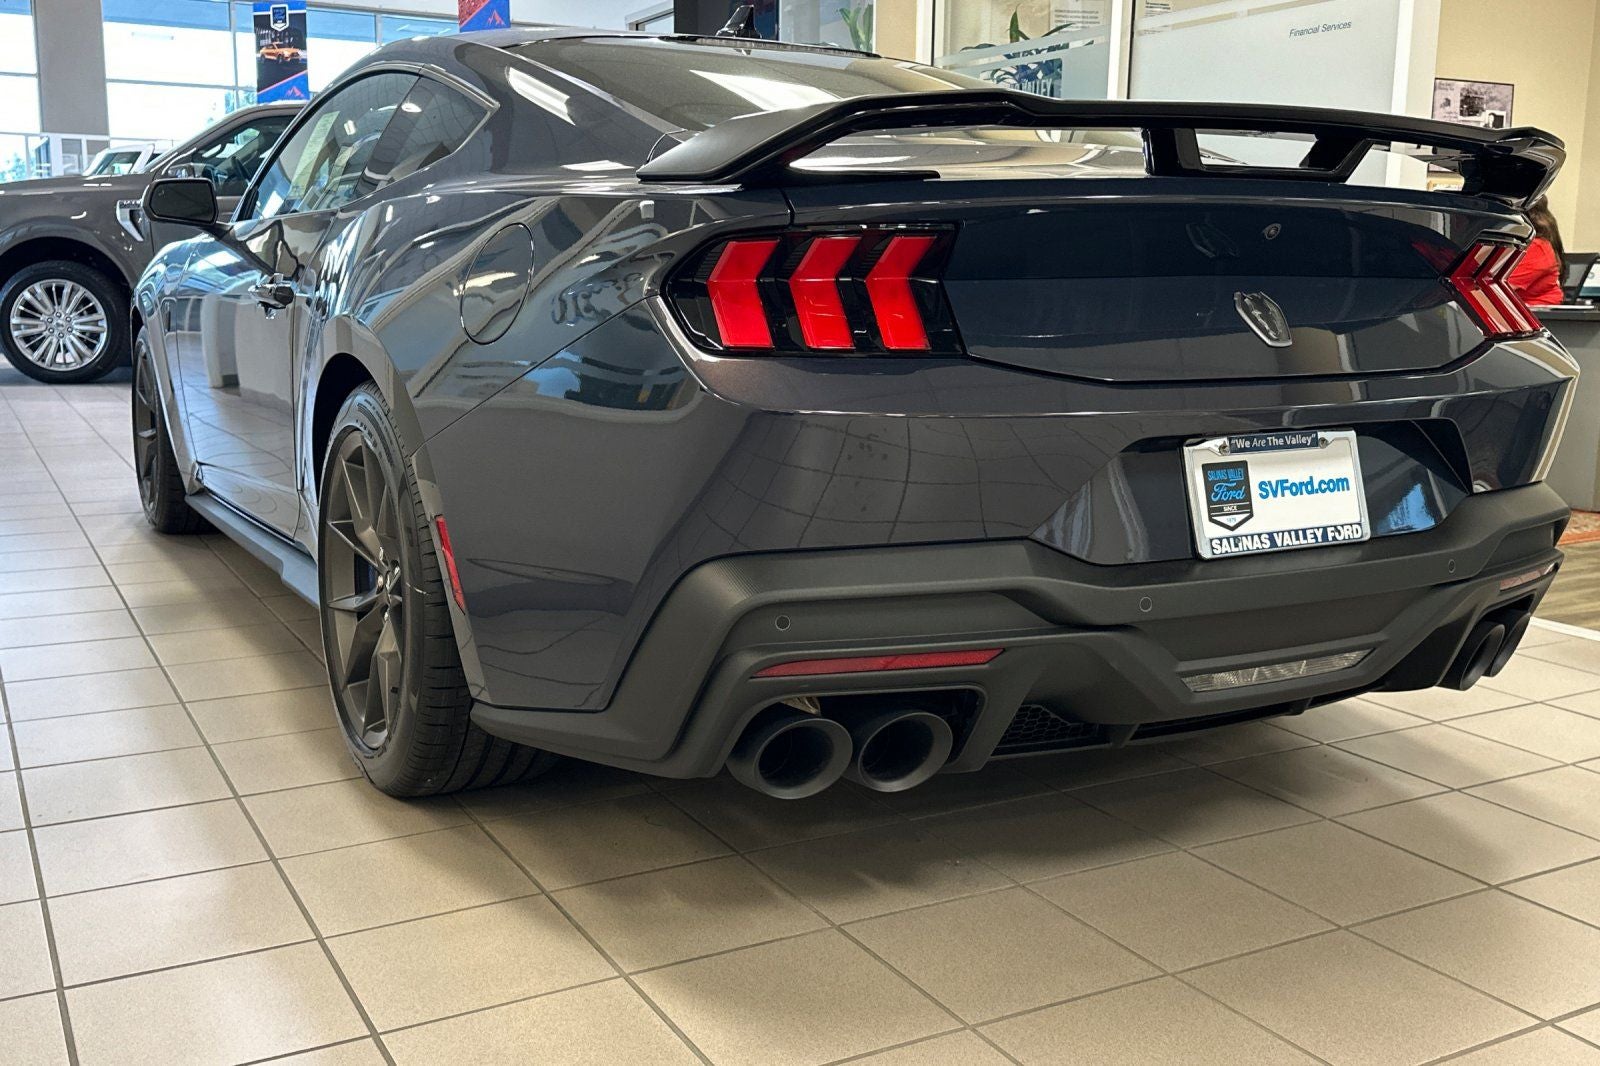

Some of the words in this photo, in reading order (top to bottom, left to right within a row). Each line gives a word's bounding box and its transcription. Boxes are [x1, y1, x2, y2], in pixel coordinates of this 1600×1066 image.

[1289, 25, 1320, 38] Financial
[1321, 22, 1352, 33] Services
[1252, 438, 1267, 447] Are
[1267, 436, 1284, 446] The
[1211, 482, 1246, 502] Ford
[1258, 475, 1350, 499] SVFord.com
[1211, 533, 1271, 554] SALINAS
[1273, 528, 1324, 547] VALLEY
[1327, 524, 1362, 541] FORD
